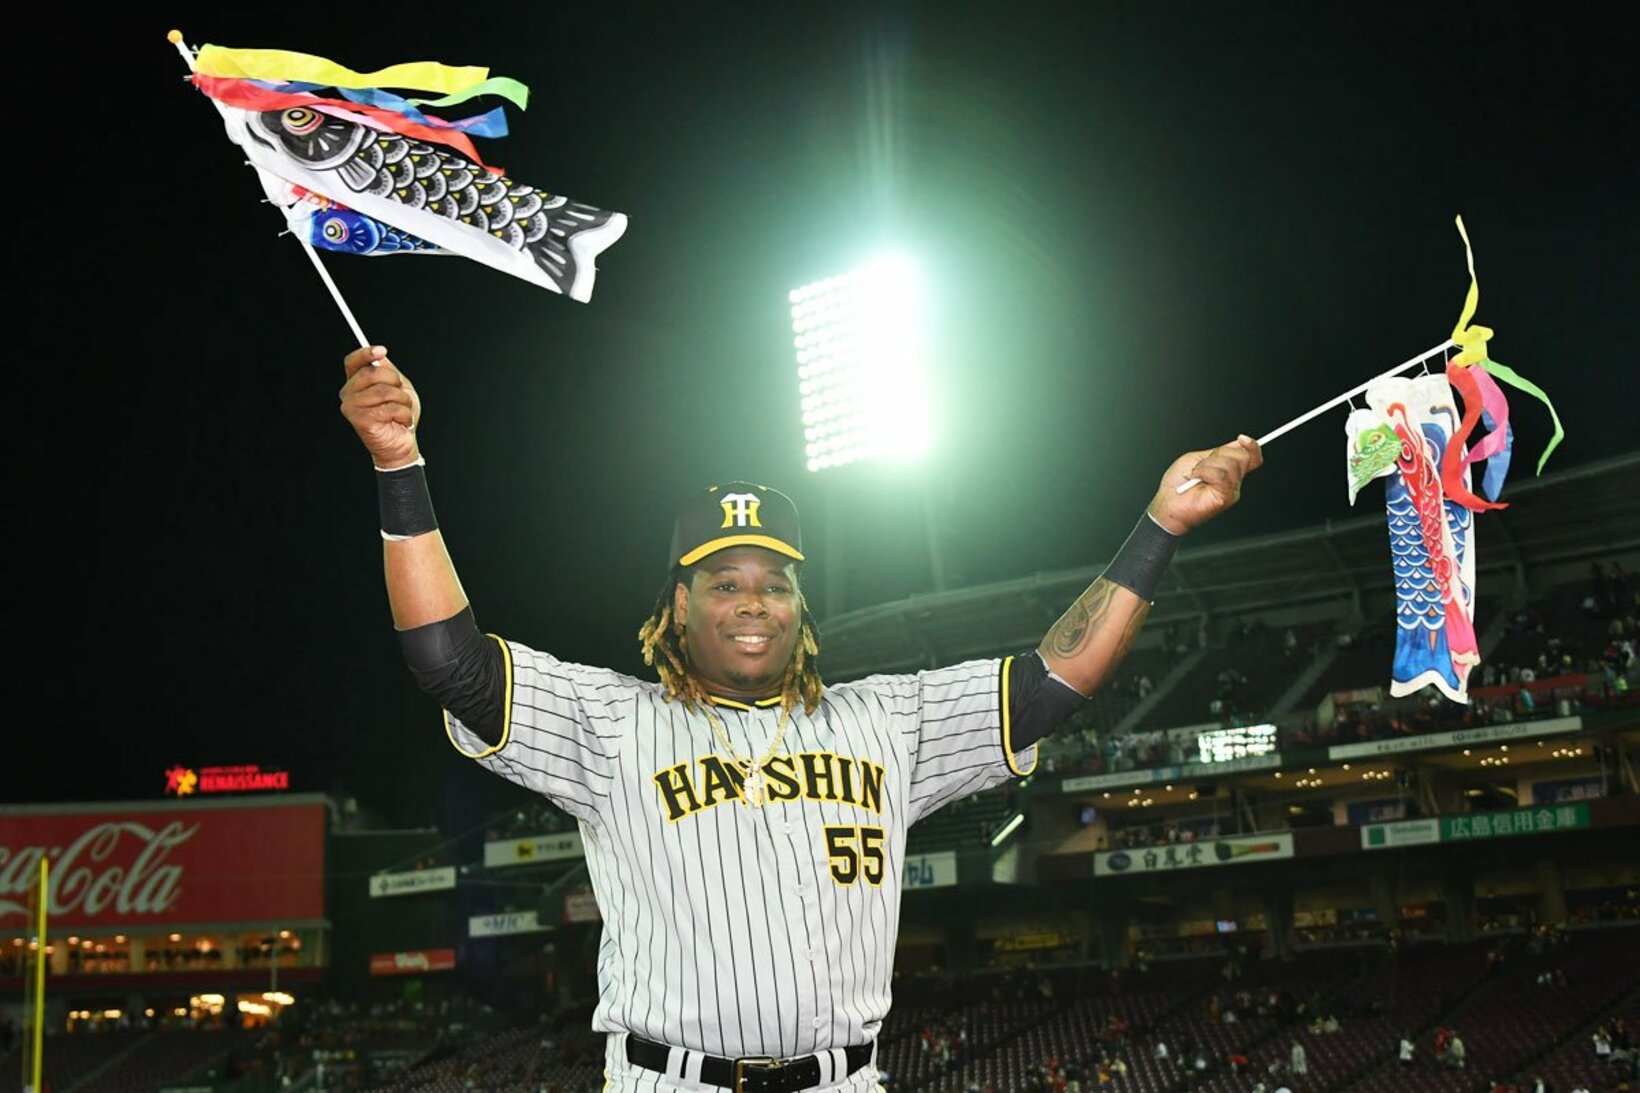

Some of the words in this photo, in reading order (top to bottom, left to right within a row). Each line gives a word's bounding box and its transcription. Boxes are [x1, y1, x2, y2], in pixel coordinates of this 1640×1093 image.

[1450, 807, 1578, 838] 広島信用金庫
[0, 821, 200, 916] a-Cola
[823, 824, 885, 887] 55
